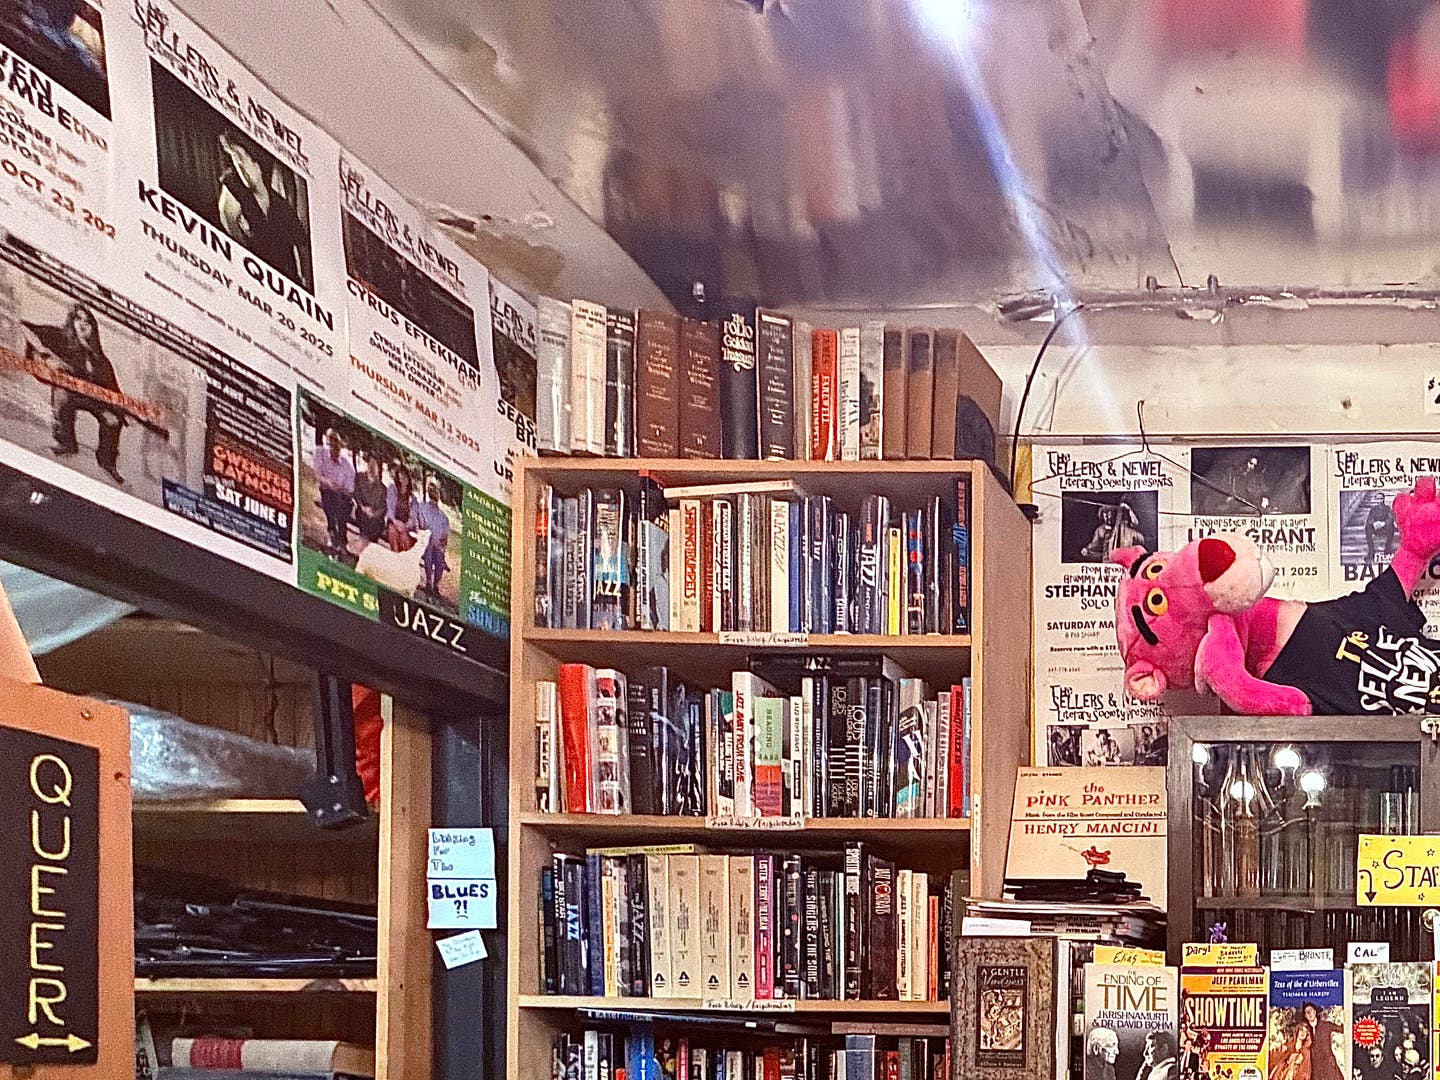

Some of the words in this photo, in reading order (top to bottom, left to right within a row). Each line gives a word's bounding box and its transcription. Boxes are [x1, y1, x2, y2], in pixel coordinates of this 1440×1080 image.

[138, 179, 233, 263] KEVIN
[243, 258, 334, 332] QUAIN
[140, 219, 233, 290] THURSDAY
[237, 286, 273, 319] MAR
[277, 309, 297, 333] 20
[300, 325, 334, 357] 2025
[347, 280, 400, 325] CYRUS
[405, 316, 481, 386] EFTEKHARI
[1335, 459, 1390, 477] SELLERS
[1395, 459, 1404, 472] &
[215, 483, 241, 505] SAT
[245, 494, 275, 524] JUNE
[278, 515, 288, 528] 8
[1251, 528, 1316, 545] GRANT
[861, 545, 875, 587] JAZZ
[394, 601, 466, 651] JAZZ
[1082, 781, 1105, 793] the
[1082, 793, 1160, 806] PANTHER
[1024, 822, 1079, 836] HENRY
[1086, 822, 1159, 834] MANCINI
[28, 754, 72, 1026] QUEER
[432, 884, 489, 900] BLUES
[566, 903, 579, 940] JAZZ
[1186, 945, 1212, 957] Daryl
[1353, 947, 1378, 958] CAL
[1104, 974, 1144, 985] ENDING
[1146, 974, 1161, 985] OF
[1211, 976, 1229, 985] JEFF
[1231, 976, 1264, 985] PEARLMAN
[1097, 984, 1169, 1012] TIME
[1102, 1011, 1170, 1021] KRISHNAMURTI
[1184, 997, 1264, 1028] SHOWTIME
